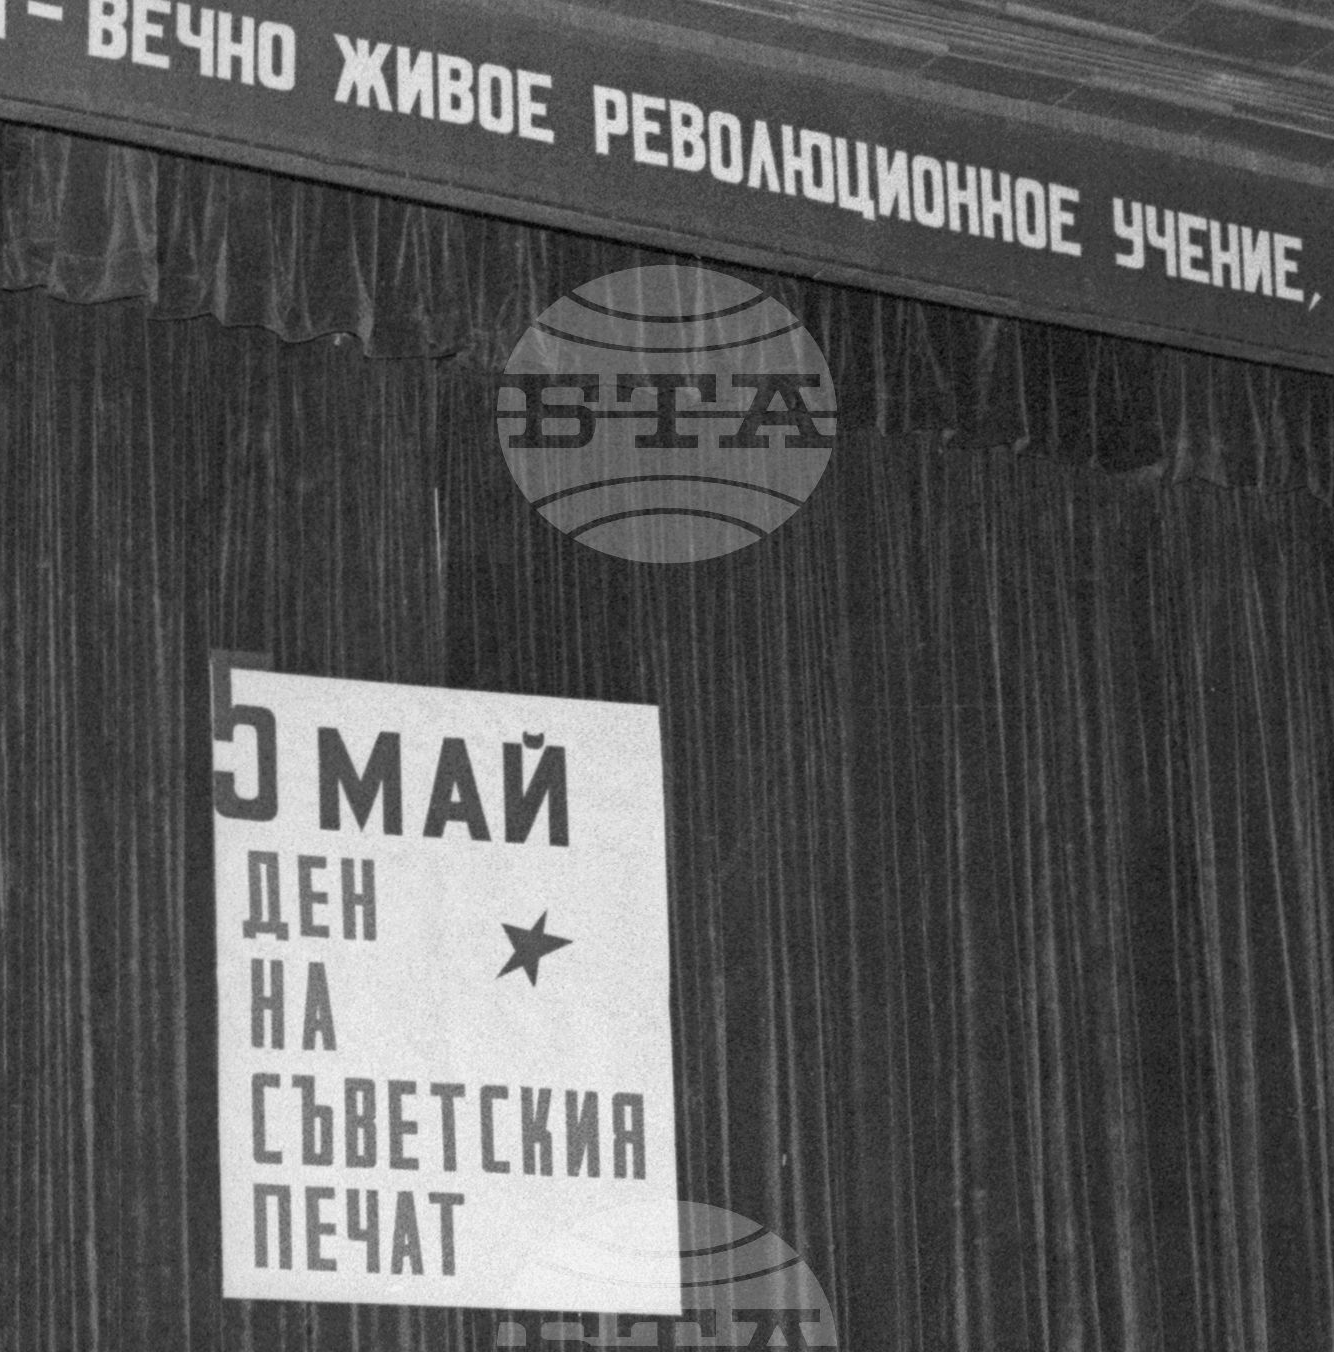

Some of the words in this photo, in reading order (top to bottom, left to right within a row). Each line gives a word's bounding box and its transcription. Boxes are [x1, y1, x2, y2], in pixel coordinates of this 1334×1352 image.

[87, 0, 297, 91] ВЕЧНО
[333, 33, 555, 144] ЖИВОЕ
[592, 84, 1082, 257] РЕВОЛЮЦИОННОЕ
[1112, 196, 1322, 312] УЧЕНИЕ,
[210, 649, 279, 822] 5
[317, 726, 570, 848] МАЙ
[242, 850, 378, 942] ДЕН
[250, 958, 337, 1051] НА
[251, 1072, 647, 1180] СЪВЕТСКИЯ
[253, 1183, 465, 1276] ПЕЧАТ
